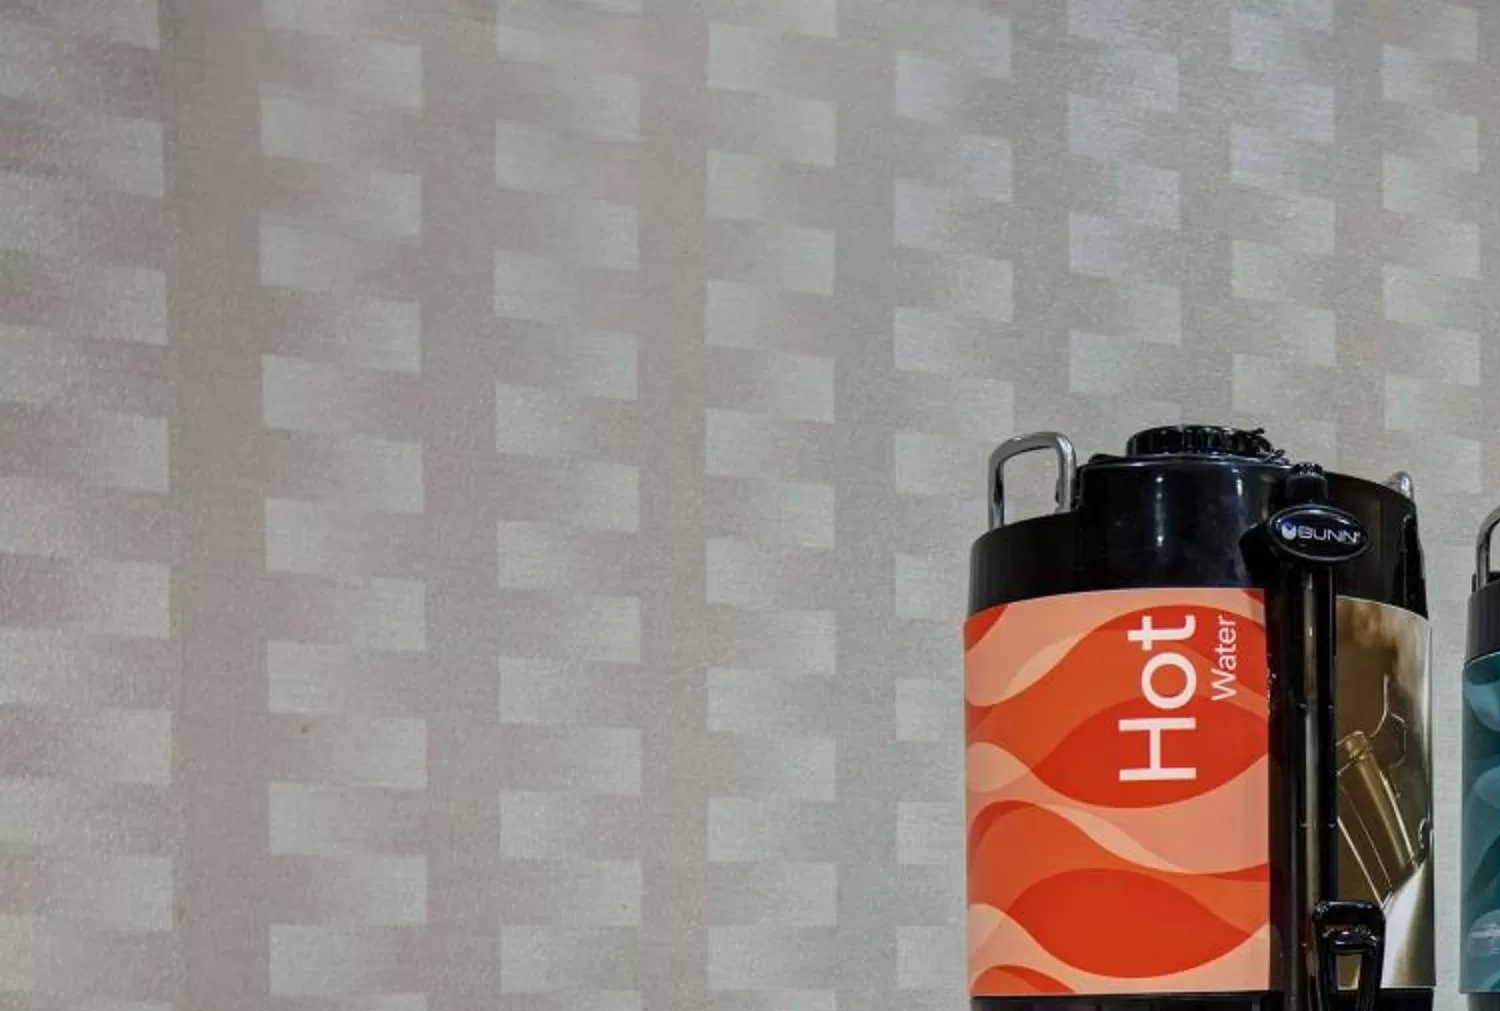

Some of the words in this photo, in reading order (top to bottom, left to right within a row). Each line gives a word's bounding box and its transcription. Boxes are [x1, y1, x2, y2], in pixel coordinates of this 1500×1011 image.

[1298, 525, 1358, 544] BUNN
[1118, 614, 1198, 782] Hot
[1210, 614, 1238, 702] Water
